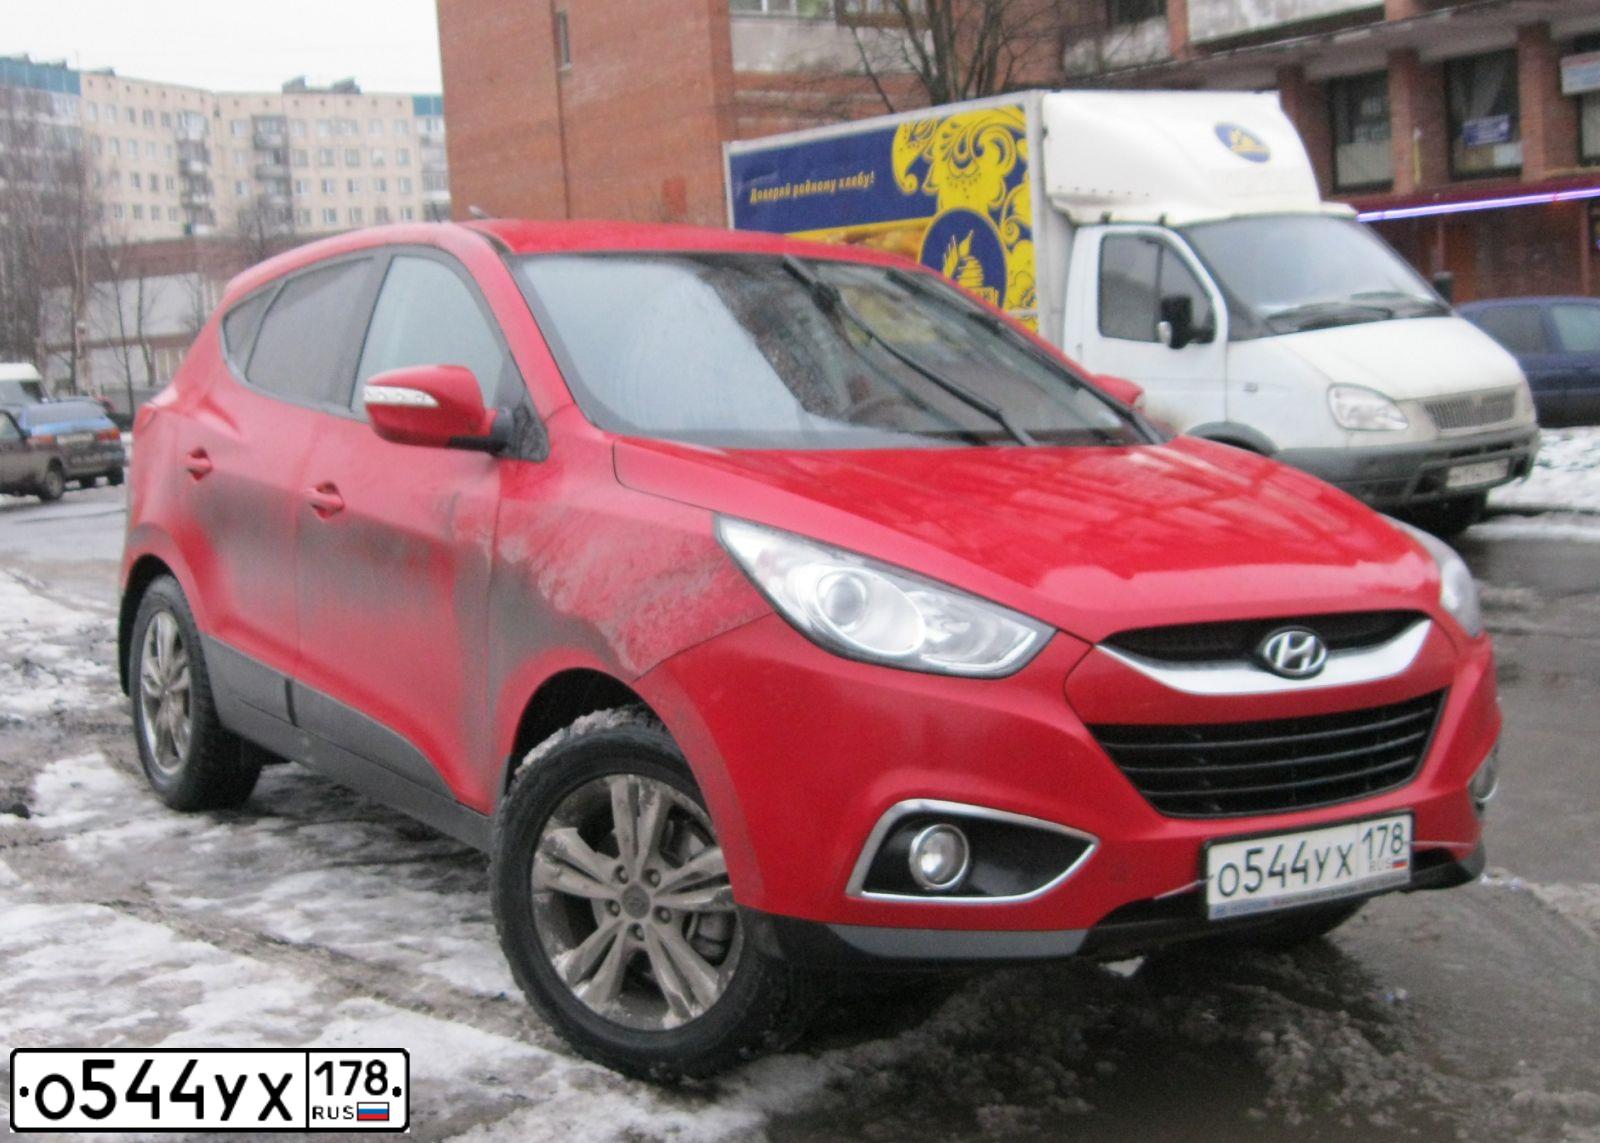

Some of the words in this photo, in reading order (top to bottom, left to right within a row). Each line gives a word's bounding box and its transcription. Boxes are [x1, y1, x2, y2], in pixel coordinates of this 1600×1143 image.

[792, 179, 837, 197] родному
[838, 170, 875, 188] хлебу!
[1362, 823, 1404, 859] 178
